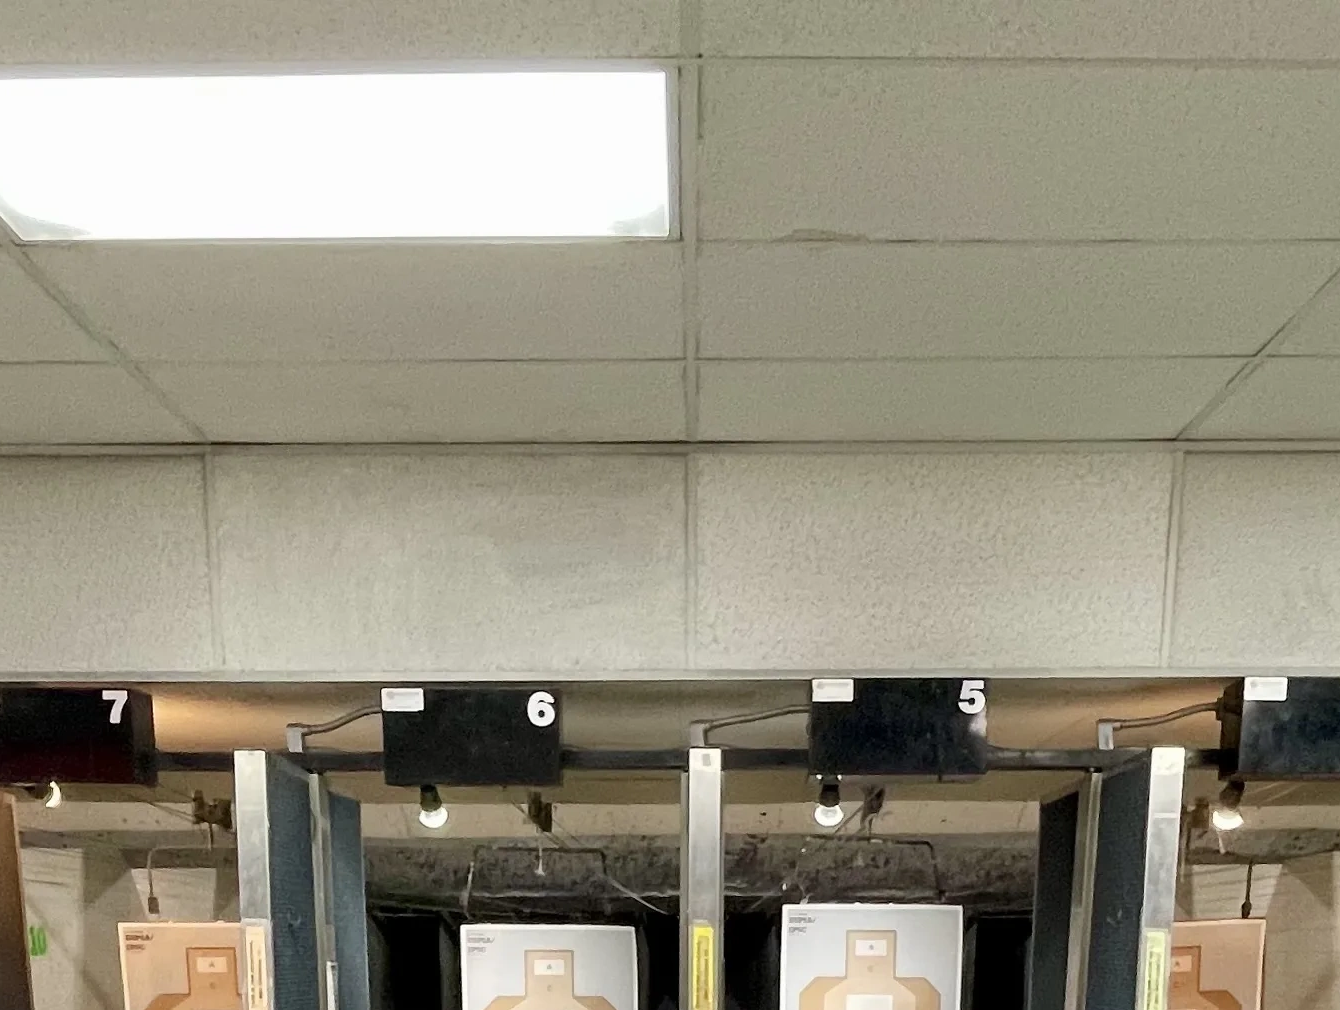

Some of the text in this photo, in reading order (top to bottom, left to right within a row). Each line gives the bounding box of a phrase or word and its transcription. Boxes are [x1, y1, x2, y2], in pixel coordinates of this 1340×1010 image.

[101, 689, 128, 724] 7
[526, 691, 556, 727] 6
[957, 679, 986, 715] 5
[28, 925, 48, 957] 10
